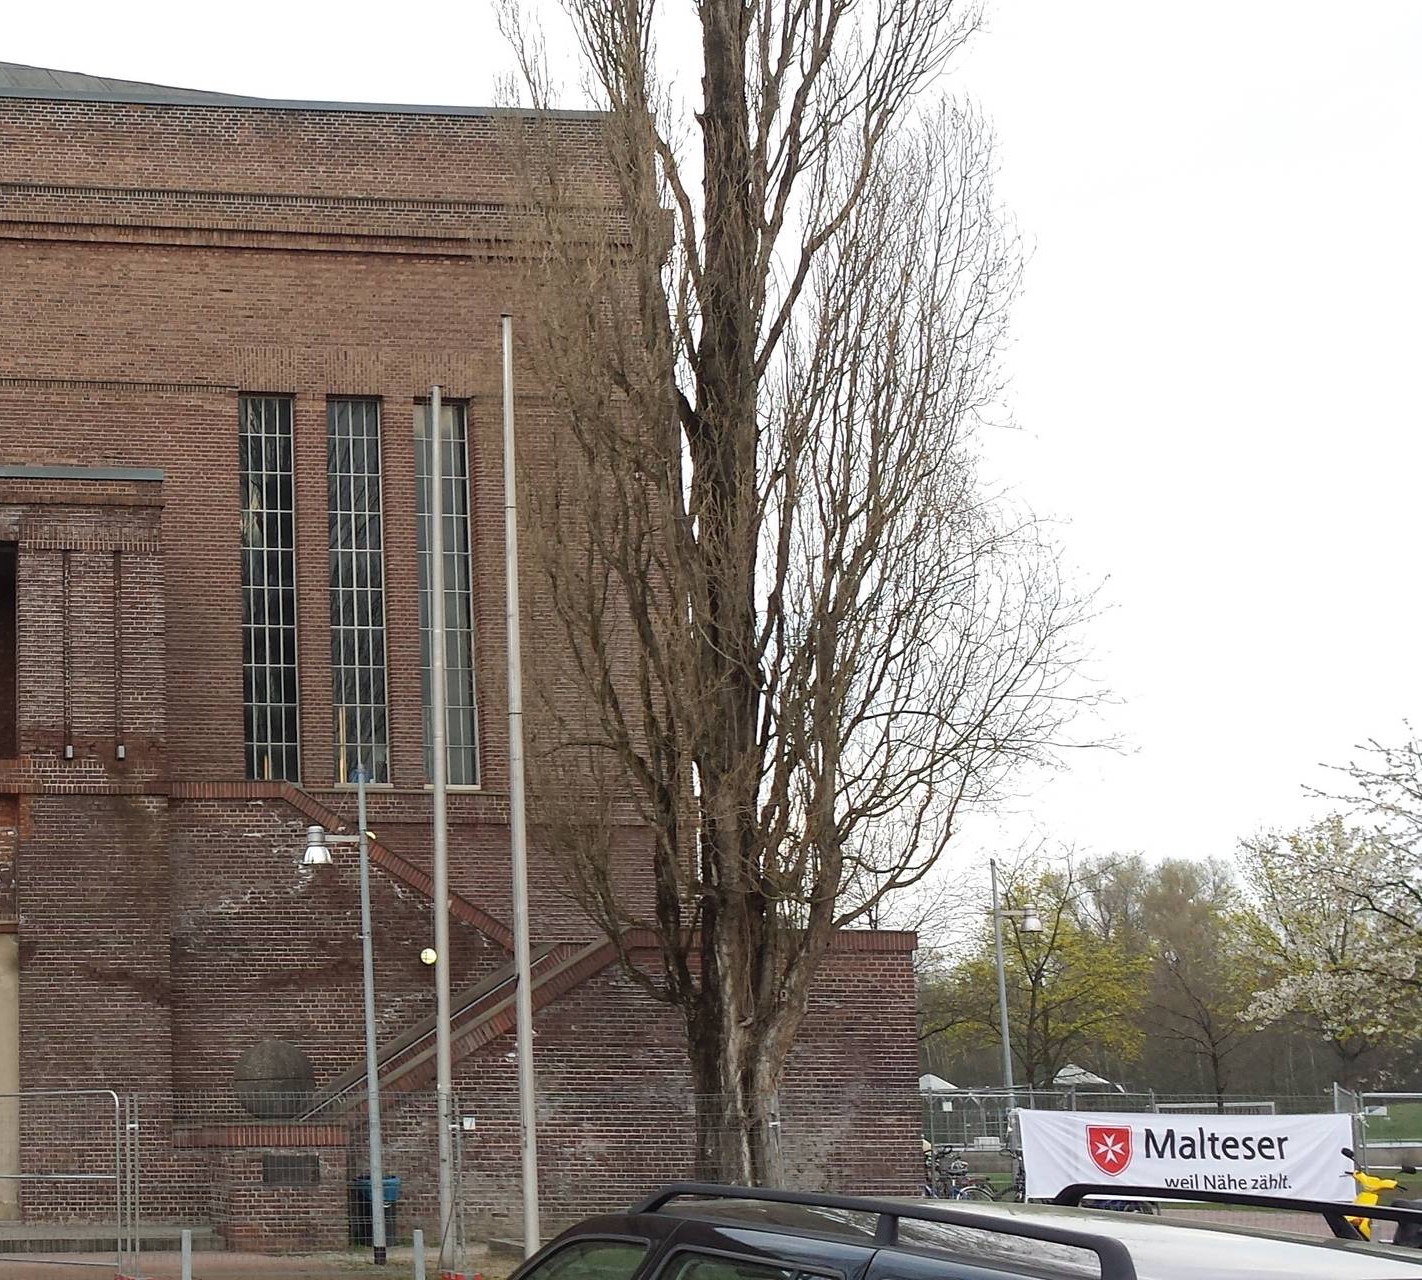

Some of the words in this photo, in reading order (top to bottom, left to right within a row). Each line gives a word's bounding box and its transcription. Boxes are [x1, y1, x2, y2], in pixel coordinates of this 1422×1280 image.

[1144, 1127, 1288, 1160] Malteser
[1164, 1174, 1198, 1189] weil
[1203, 1174, 1247, 1190] Nähe
[1251, 1173, 1292, 1189] zählt.
